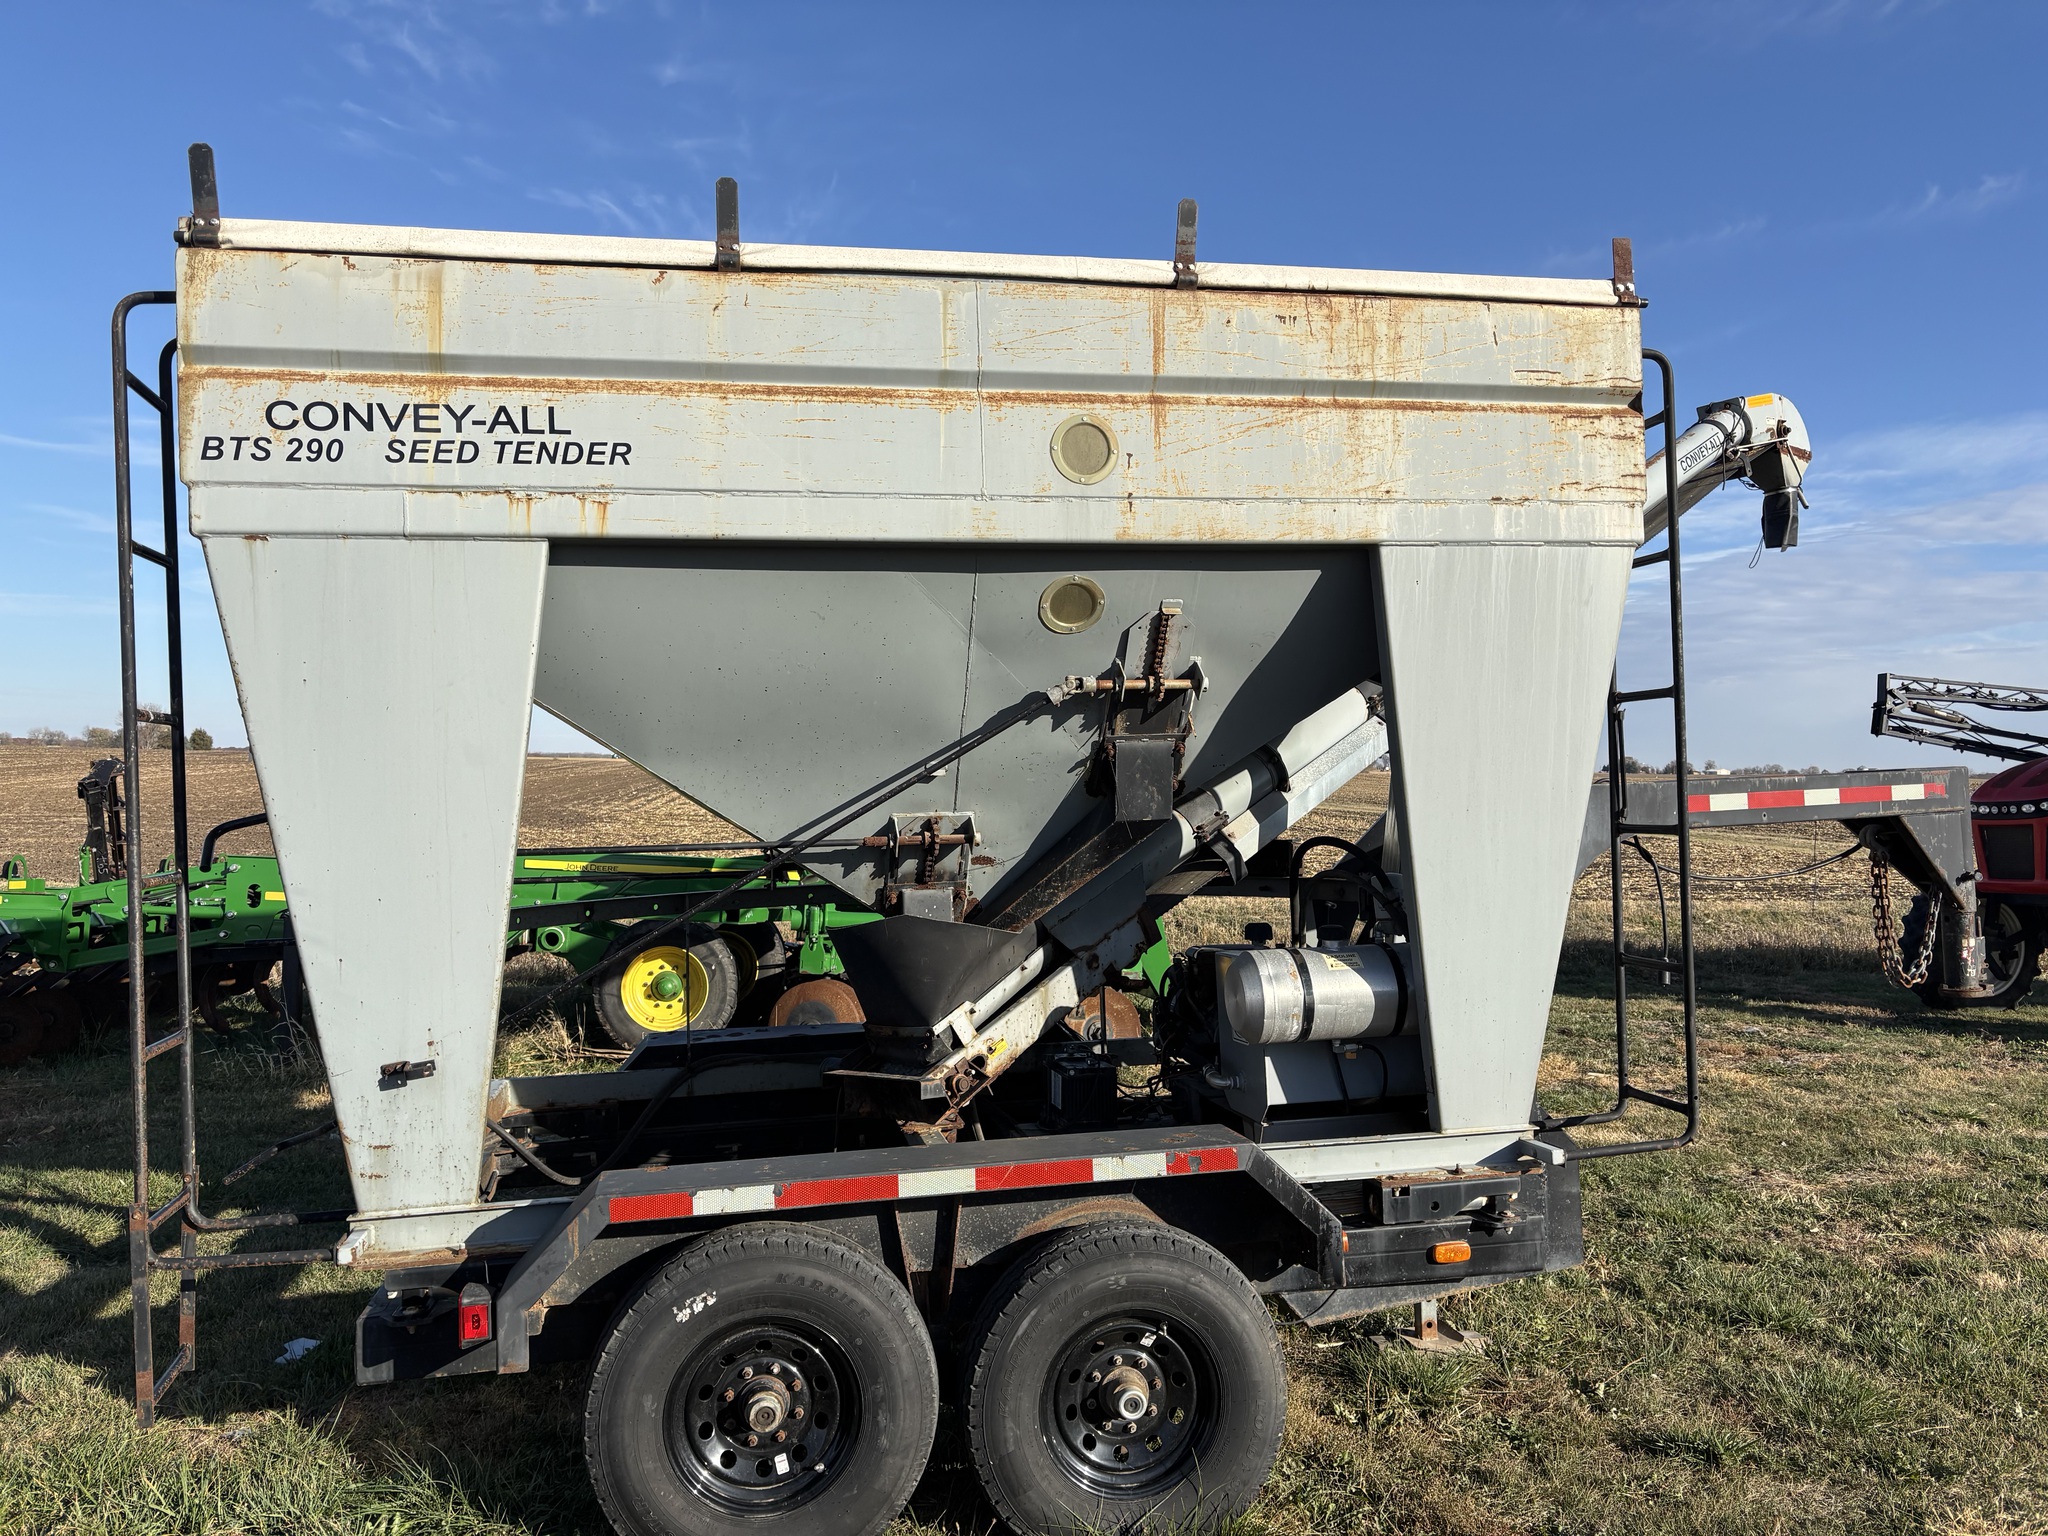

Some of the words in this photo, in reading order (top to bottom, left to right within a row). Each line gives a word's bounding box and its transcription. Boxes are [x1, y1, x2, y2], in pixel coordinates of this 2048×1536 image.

[265, 400, 572, 435] CONVEY-ALL
[200, 436, 273, 462] BTS
[285, 437, 344, 463] 290
[384, 439, 480, 464] SEED
[493, 440, 632, 466] TENDER
[1680, 435, 1723, 471] CONVEY-ALL
[564, 863, 588, 871] JOHN
[589, 864, 619, 872] DEERE
[775, 1272, 871, 1322] KARRIER
[999, 1316, 1046, 1417] KARRIER
